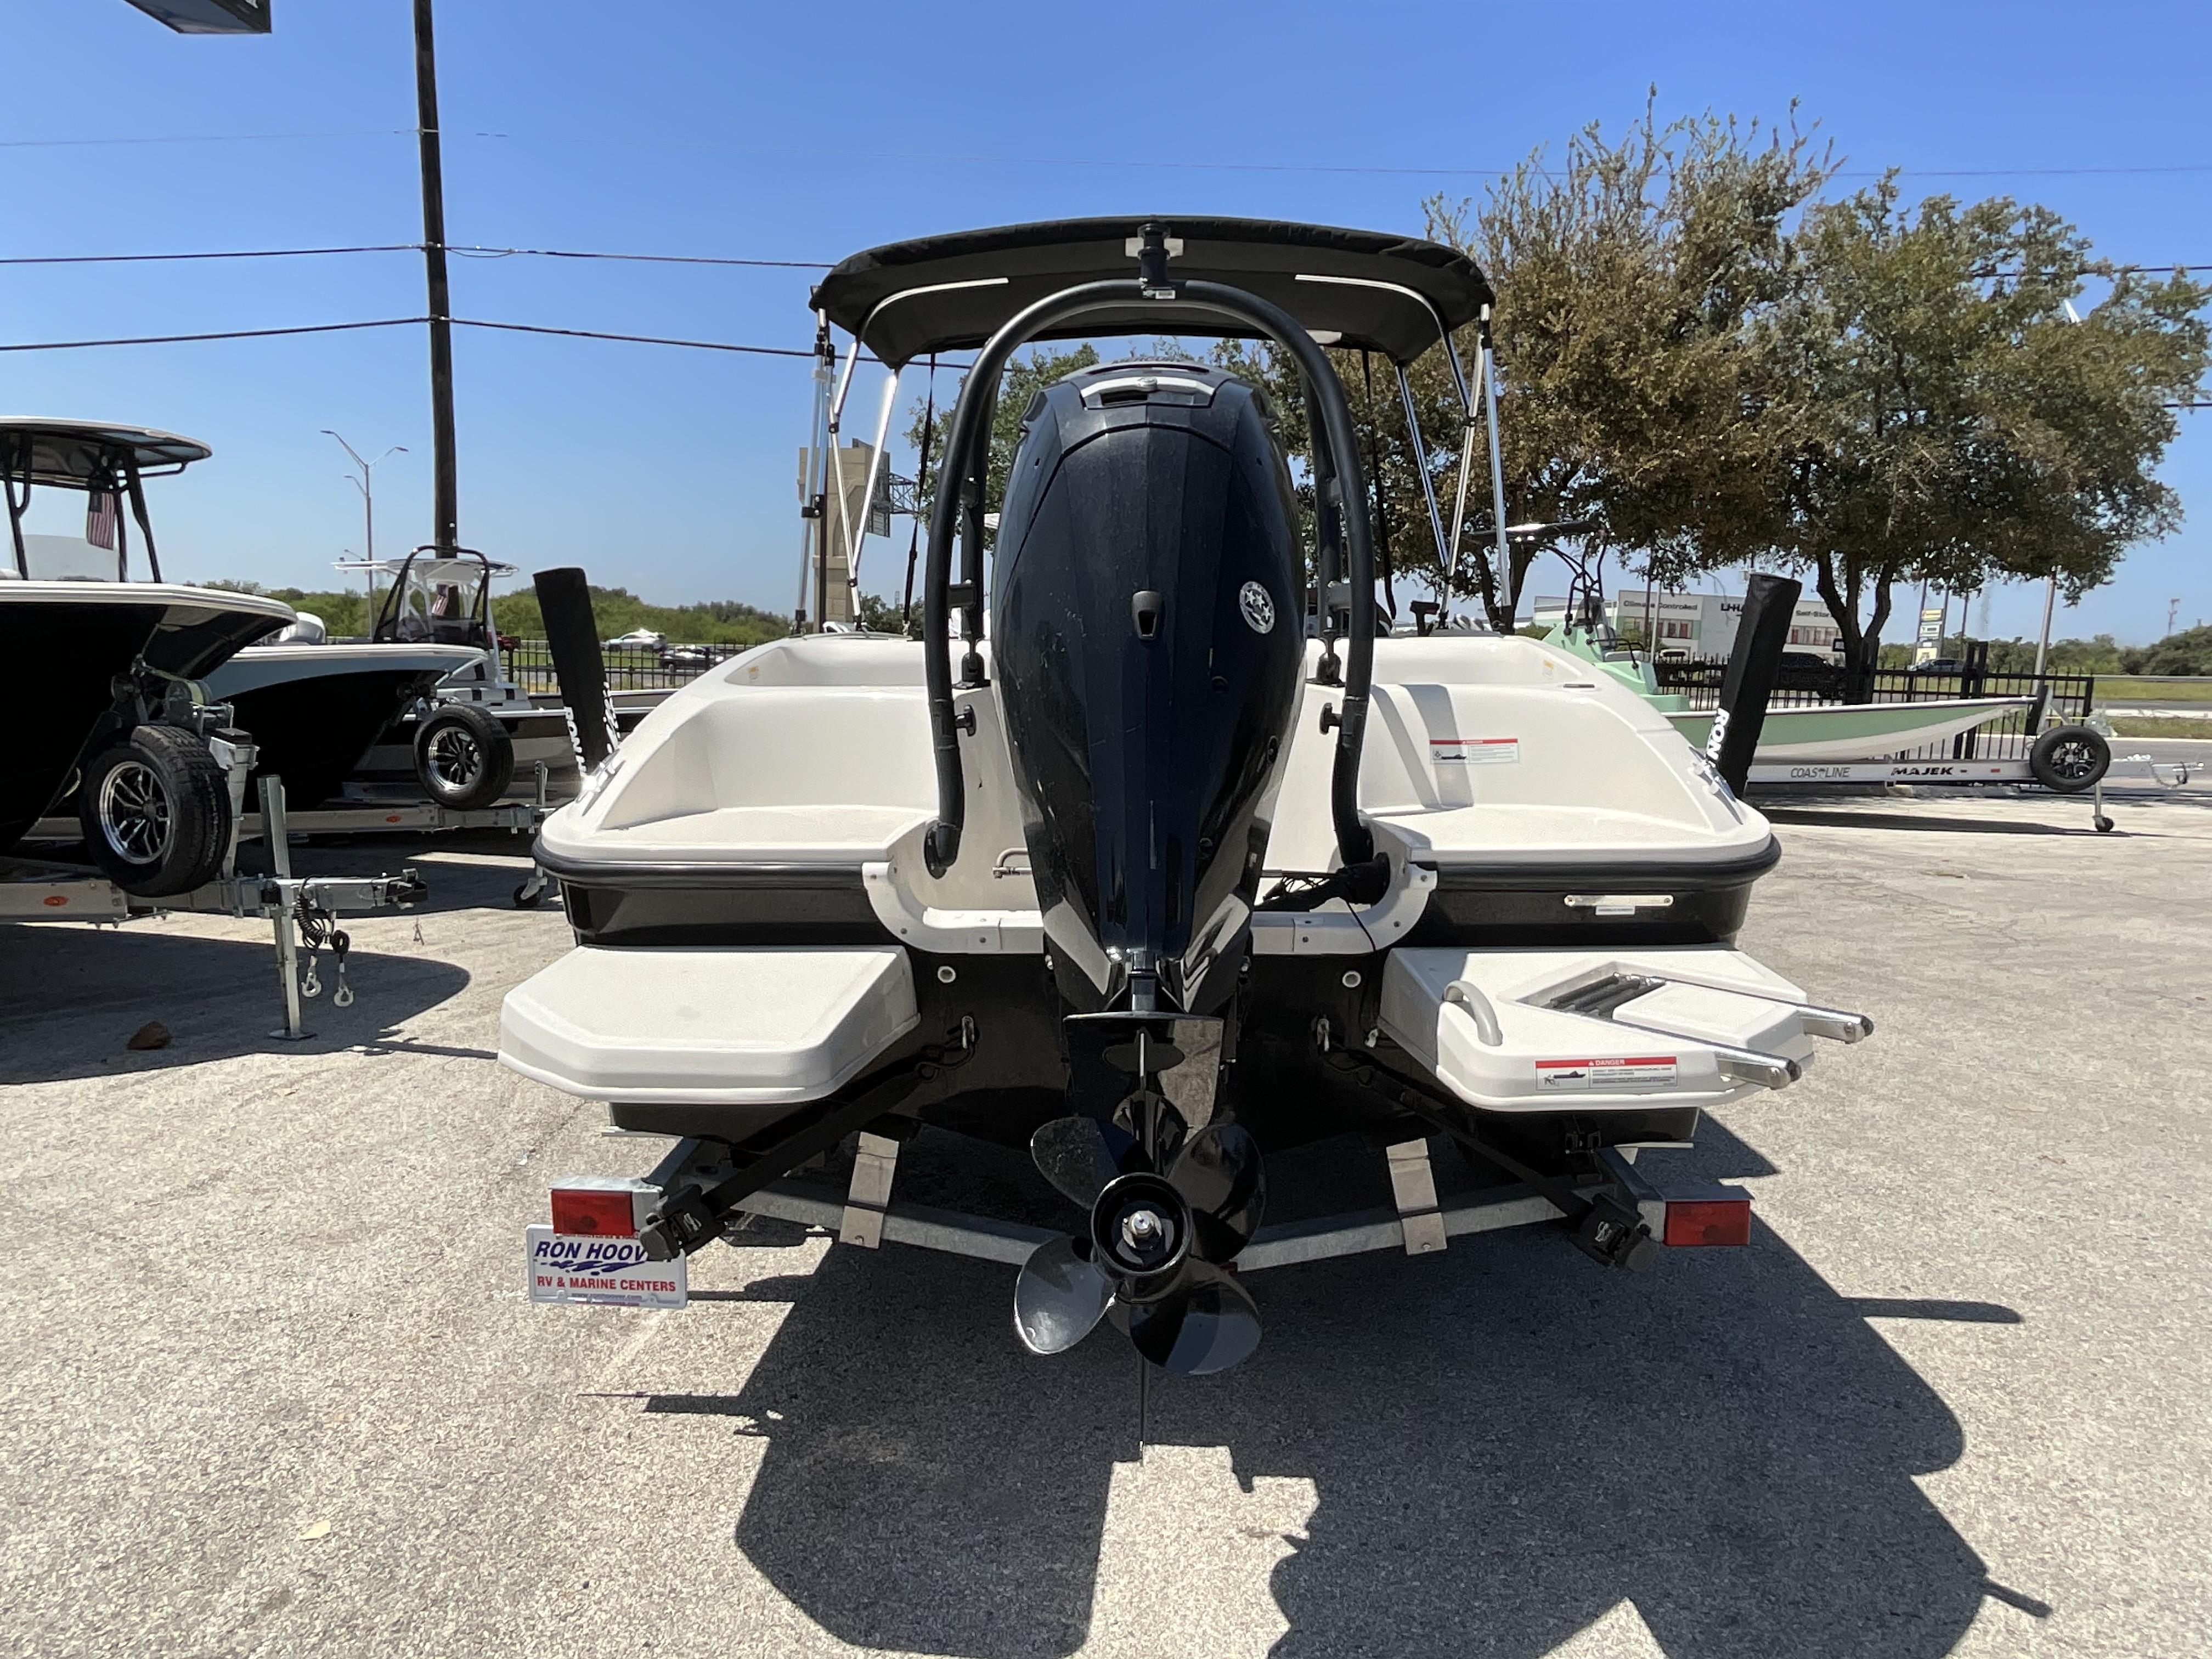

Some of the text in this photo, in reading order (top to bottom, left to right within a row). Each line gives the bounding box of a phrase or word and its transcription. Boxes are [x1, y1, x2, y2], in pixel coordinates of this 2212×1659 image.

[1891, 767, 1954, 776] MAJEK
[534, 1241, 647, 1261] RON HOOV
[537, 1276, 676, 1292] RV & MARINE CENTERS
